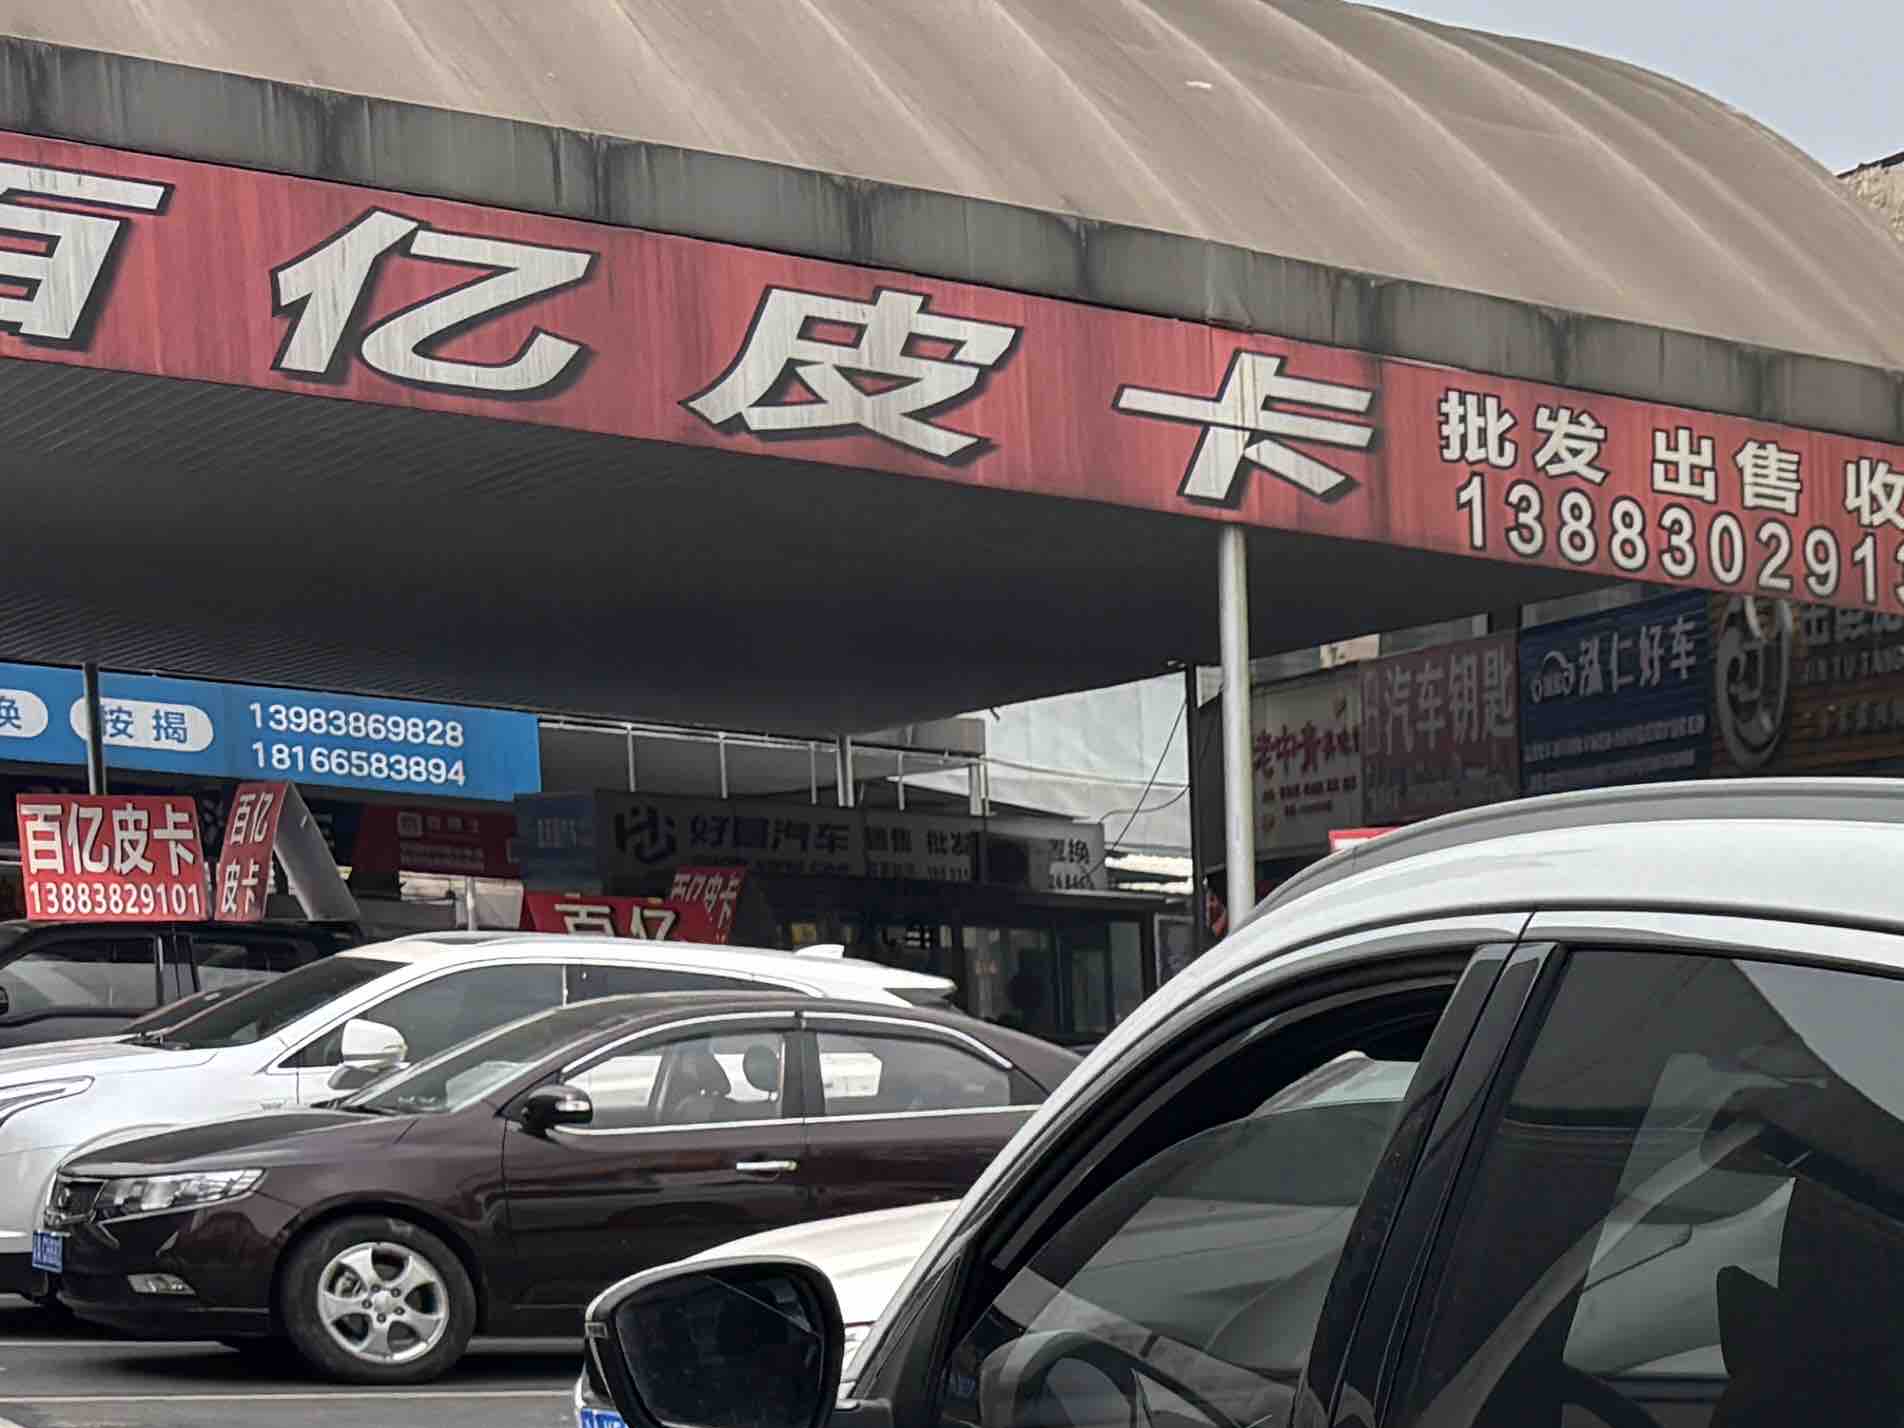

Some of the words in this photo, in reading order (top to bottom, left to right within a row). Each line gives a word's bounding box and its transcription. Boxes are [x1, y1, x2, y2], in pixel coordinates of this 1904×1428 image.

[1438, 388, 1610, 485] 批发
[1651, 425, 1802, 516] 出售
[248, 701, 465, 748] 13983869828
[252, 740, 466, 787] 18166583894
[20, 802, 197, 876] 百亿皮卡
[229, 791, 271, 845] 百亿
[28, 881, 201, 916] 13883829101
[221, 858, 260, 913] 皮卡
